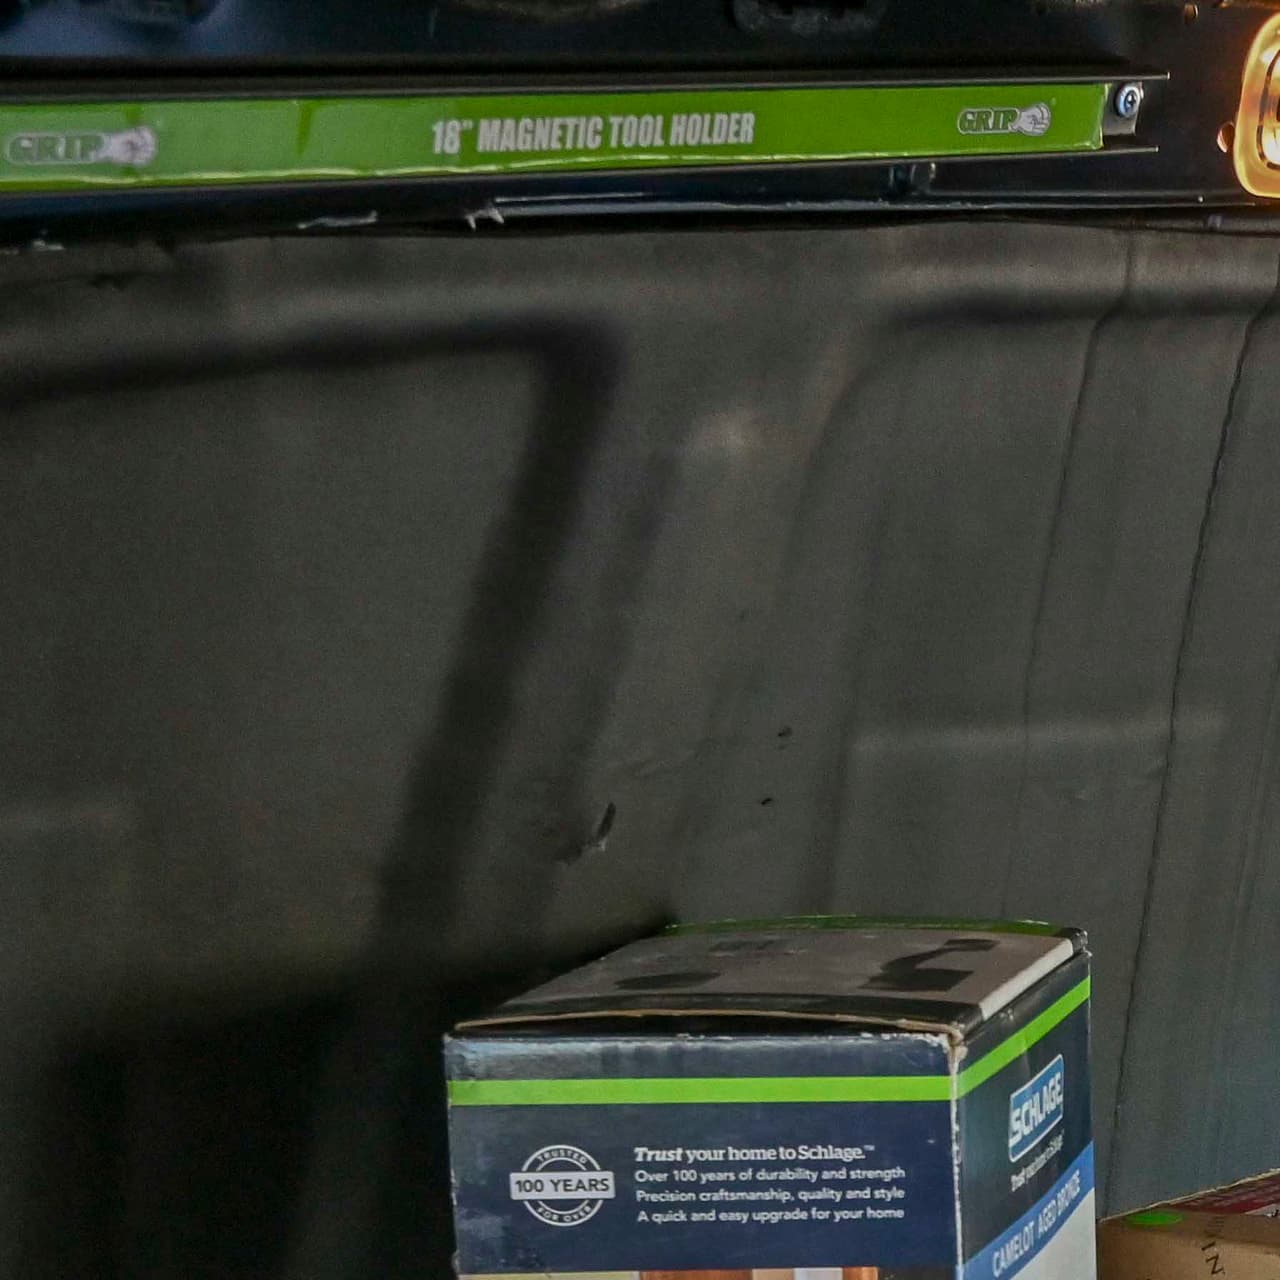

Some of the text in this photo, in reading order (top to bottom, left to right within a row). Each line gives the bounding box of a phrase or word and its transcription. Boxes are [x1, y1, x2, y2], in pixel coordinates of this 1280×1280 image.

[960, 109, 1018, 134] GRIP
[433, 112, 755, 154] 18" MAGNETIC TOOL HOLDER
[1009, 1071, 1064, 1146] SCHLAGE
[537, 1149, 588, 1165] TRUSTED
[634, 1147, 682, 1161] Trust
[687, 1149, 726, 1164] your
[729, 1147, 777, 1160] home
[780, 1147, 796, 1160] to
[634, 1167, 905, 1184] Over 100 years of durability and strength
[516, 1178, 610, 1193] 100 YEARS
[636, 1187, 905, 1203] Precision craftsmanship, quality and style
[637, 1207, 905, 1224] A quick and easy upgrade for your home
[992, 1220, 1035, 1278] CAMELOT
[1037, 1198, 1056, 1235] AGED
